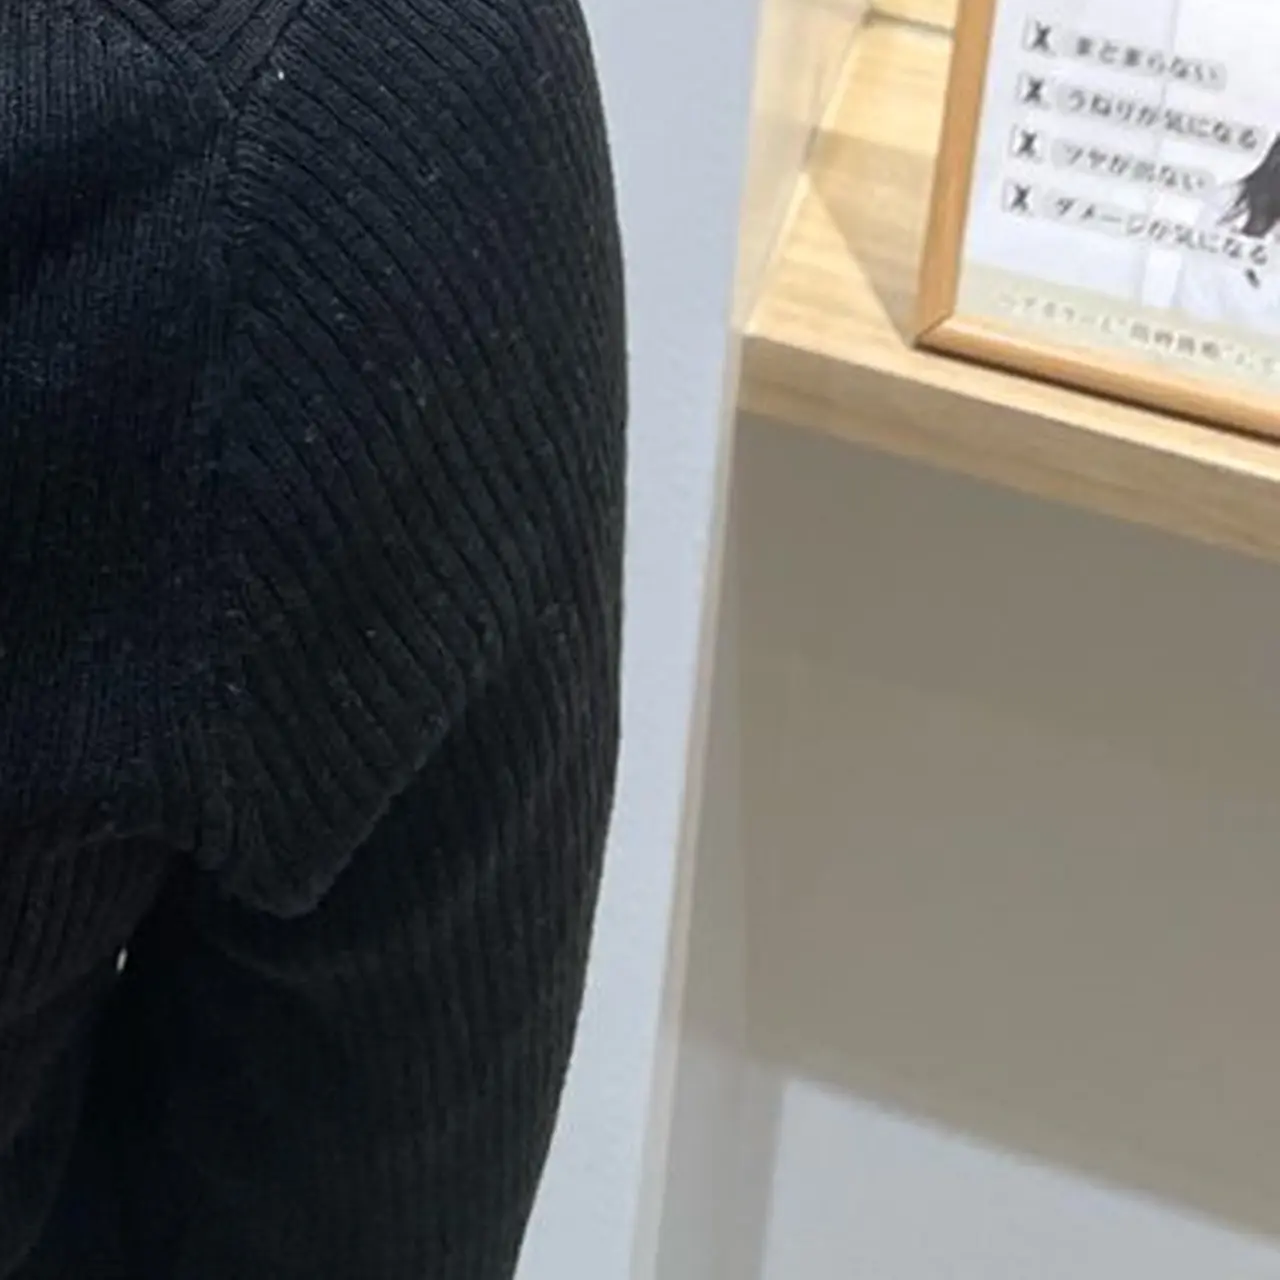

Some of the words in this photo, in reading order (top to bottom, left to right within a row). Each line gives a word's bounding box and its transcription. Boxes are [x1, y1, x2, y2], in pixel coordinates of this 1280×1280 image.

[1076, 37, 1220, 81] まとまらない
[1068, 89, 1258, 151] うねりが気になる
[1054, 196, 1268, 265] ダメージが気になる
